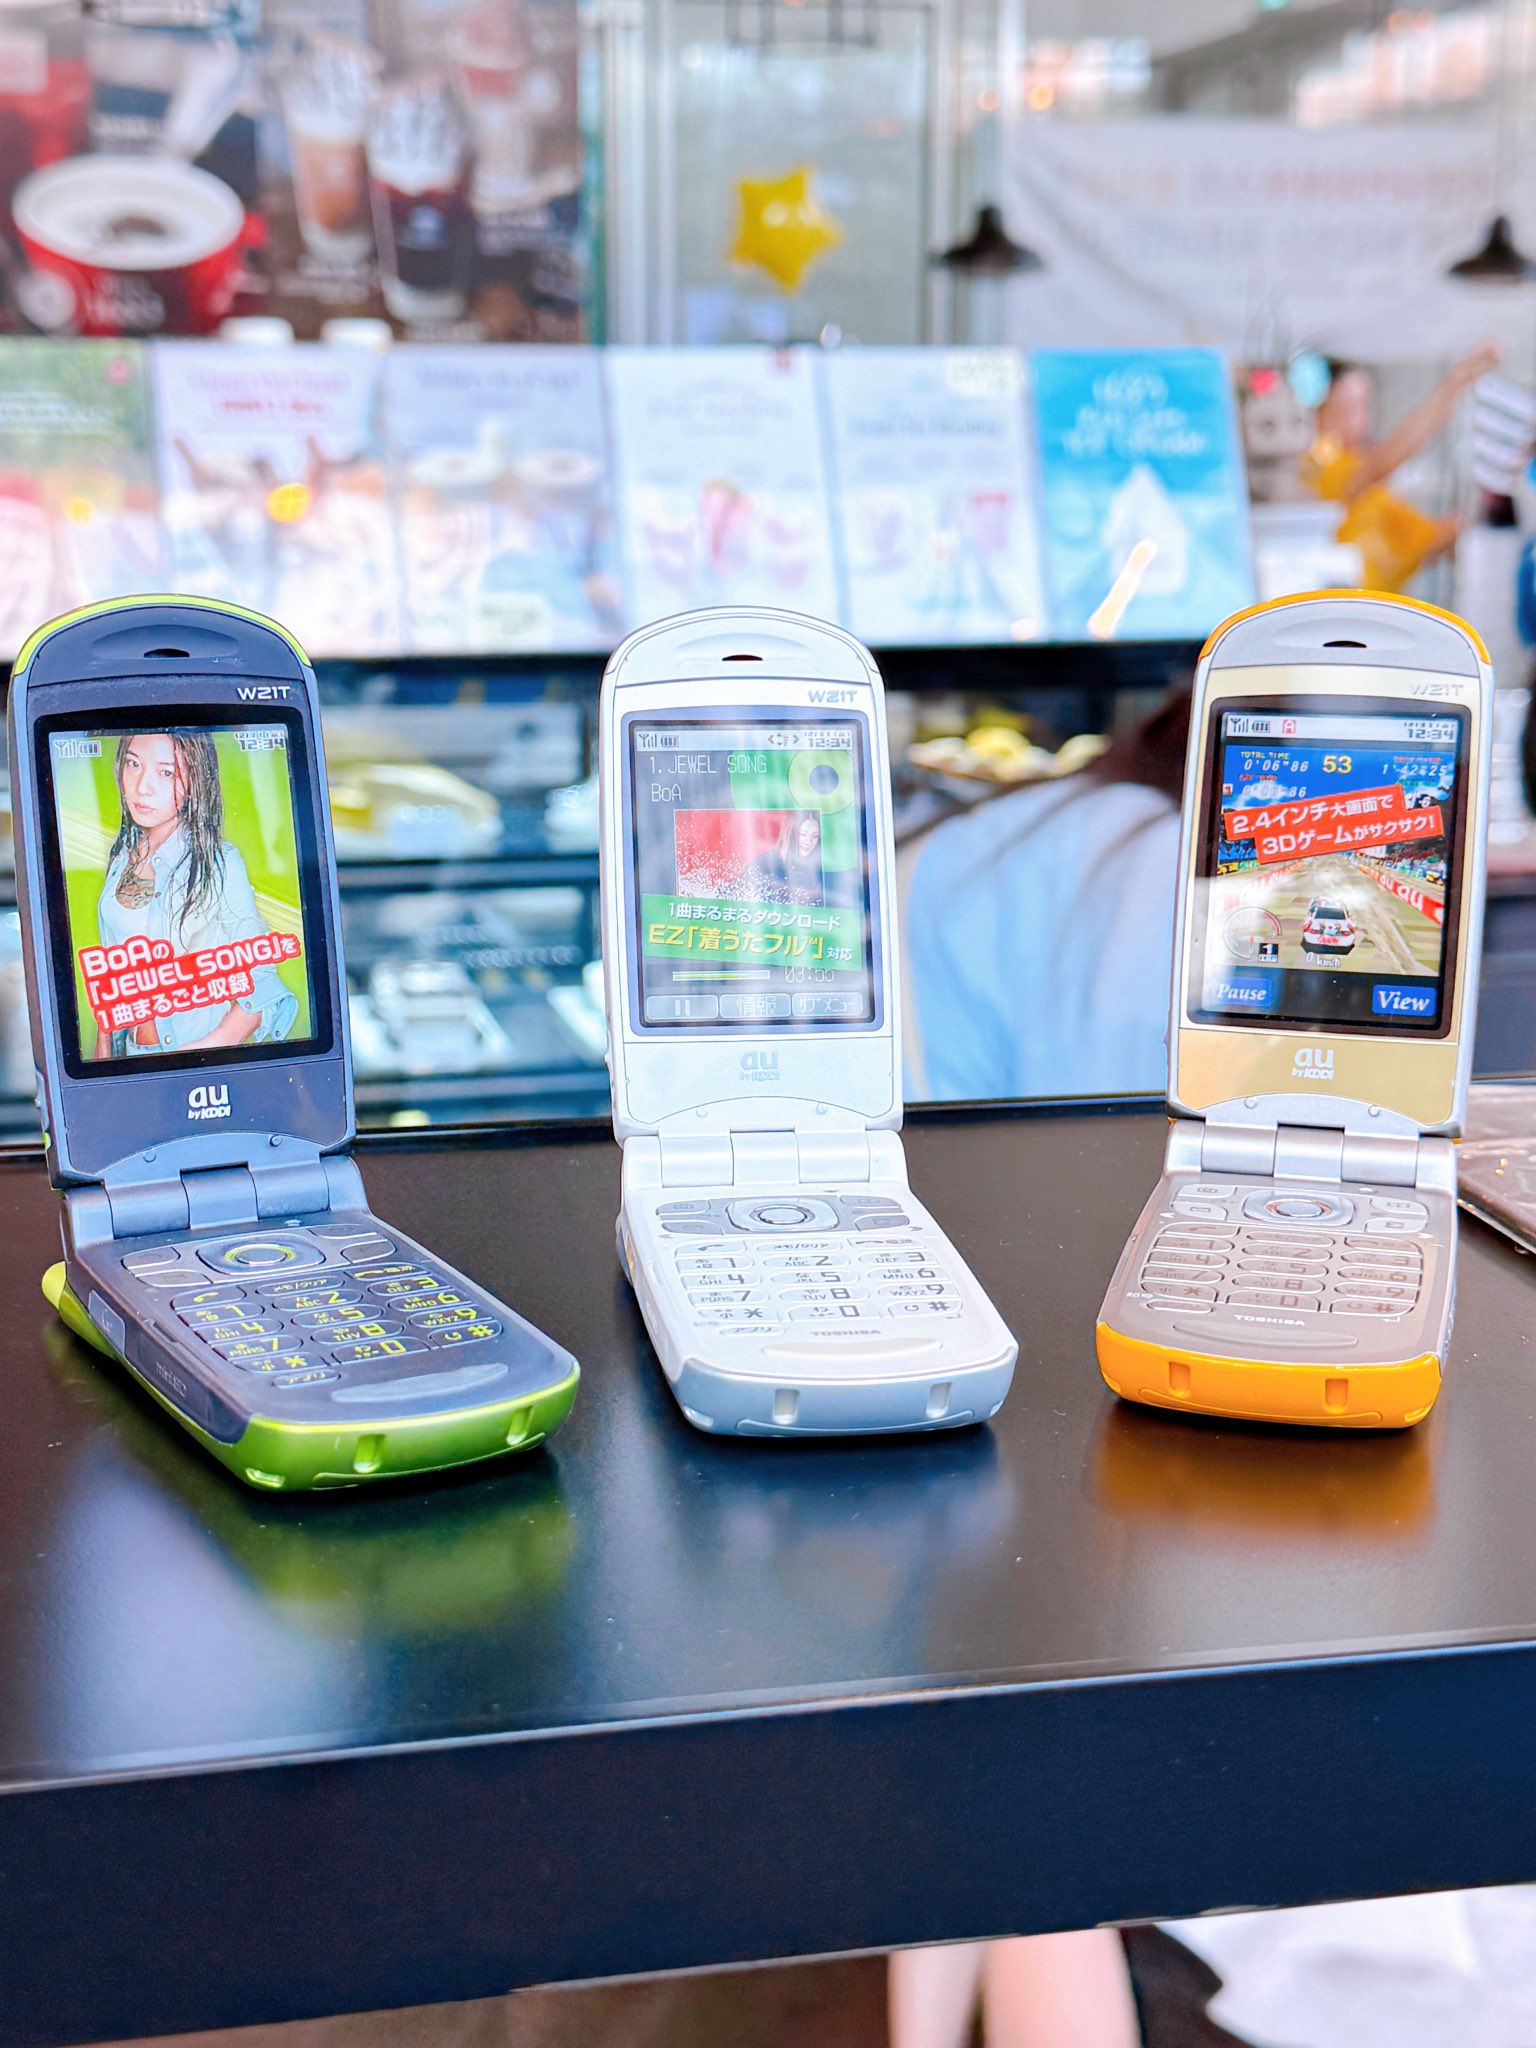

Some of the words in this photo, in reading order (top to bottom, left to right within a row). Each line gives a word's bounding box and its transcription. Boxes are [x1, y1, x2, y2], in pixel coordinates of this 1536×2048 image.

[237, 686, 290, 700] W21T
[808, 690, 858, 703] W21T
[1409, 684, 1464, 697] W21T
[1407, 729, 1454, 740] 12:34
[239, 738, 285, 751] 12:34
[807, 737, 851, 748] 12:34
[668, 755, 717, 774] JEWEL
[727, 755, 767, 773] SONG
[1322, 755, 1352, 774] 53
[651, 783, 682, 802] BoA
[1232, 794, 1393, 835] 2.4インチ大画面で
[1262, 815, 1436, 855] 3Dゲームがサクサク!
[1397, 885, 1424, 912] au
[669, 902, 841, 932] 1曲まるまるダウンロード
[81, 938, 170, 977] BoAの
[1216, 983, 1268, 1002] Pause
[97, 972, 251, 1029] 1曲まるごと収録
[736, 995, 777, 1017] 情報
[1378, 990, 1431, 1012] View
[740, 1051, 779, 1070] au
[1294, 1047, 1334, 1069] au
[188, 1084, 229, 1108] au
[187, 1109, 201, 1120] by
[811, 1255, 833, 1266] 2
[904, 1252, 925, 1262] 3
[728, 1274, 745, 1284] 4
[820, 1271, 842, 1283] 5
[917, 1267, 936, 1279] 6
[412, 1276, 440, 1288] 3
[733, 1290, 752, 1301] 7
[830, 1287, 851, 1299] 8
[926, 1283, 945, 1295] 9
[318, 1291, 348, 1304] 2
[437, 1293, 461, 1304] 6
[224, 1304, 245, 1317] 1
[338, 1307, 366, 1320] 5
[454, 1307, 478, 1320] 9
[241, 1321, 265, 1333] 4
[1234, 1314, 1306, 1327] TOSHIBA
[358, 1323, 387, 1337] 8
[260, 1336, 279, 1351] 7
